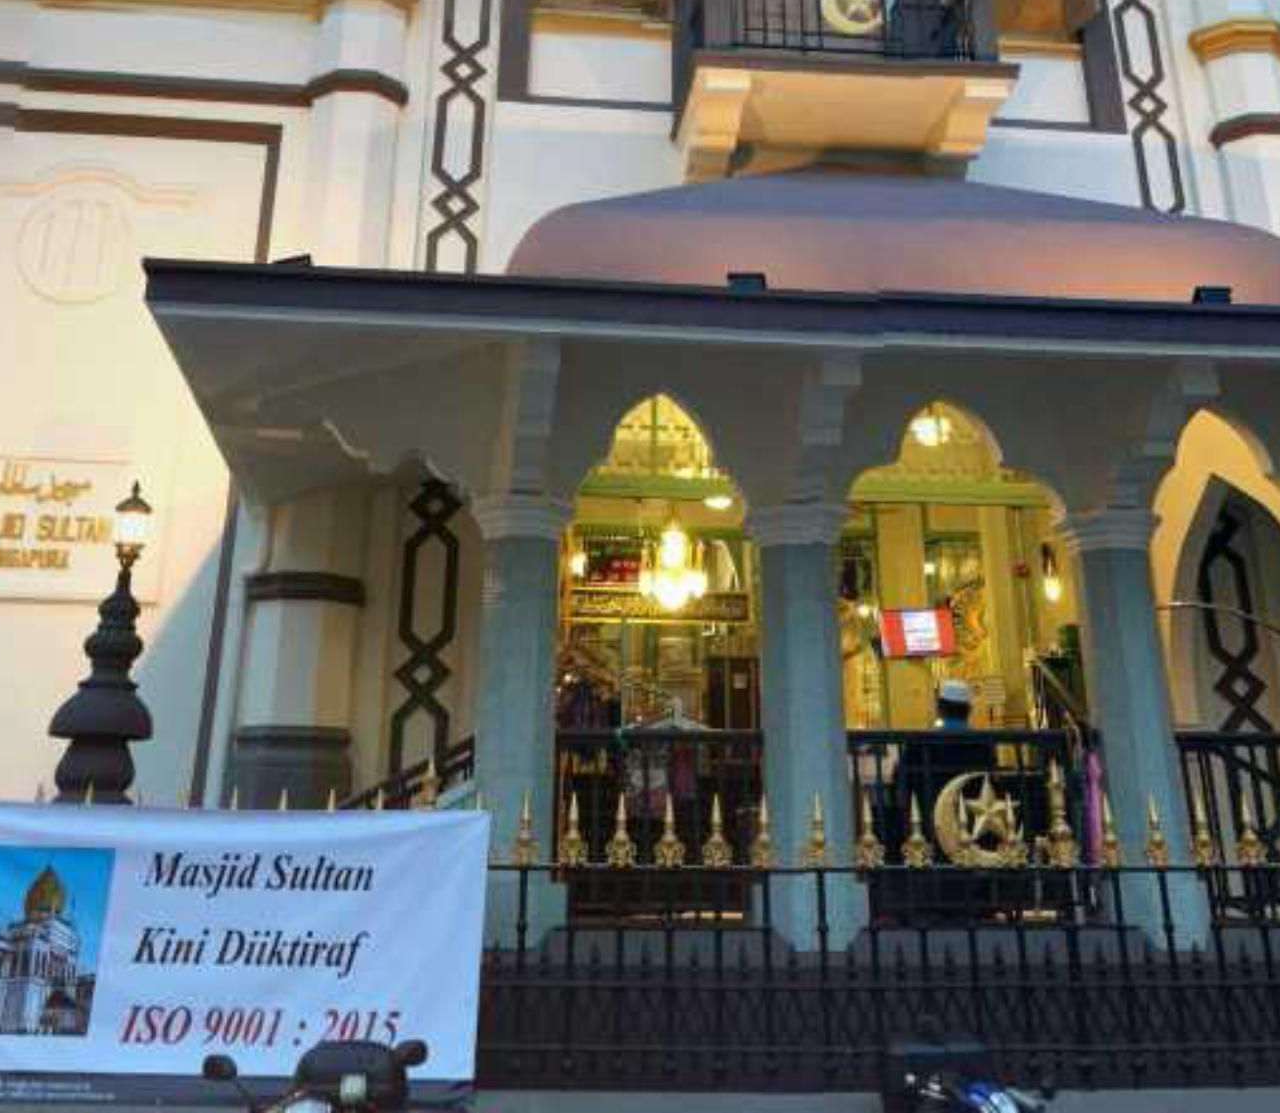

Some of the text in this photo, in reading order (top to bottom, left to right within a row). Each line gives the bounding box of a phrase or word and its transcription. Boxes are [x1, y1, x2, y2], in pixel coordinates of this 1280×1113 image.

[36, 513, 112, 542] SULTAN
[144, 852, 375, 898] Masjid Sultan
[133, 927, 371, 980] Kini Diiktiraf
[120, 1004, 193, 1046] ISO
[204, 1006, 284, 1047] 9001
[322, 1008, 403, 1042] 2015
